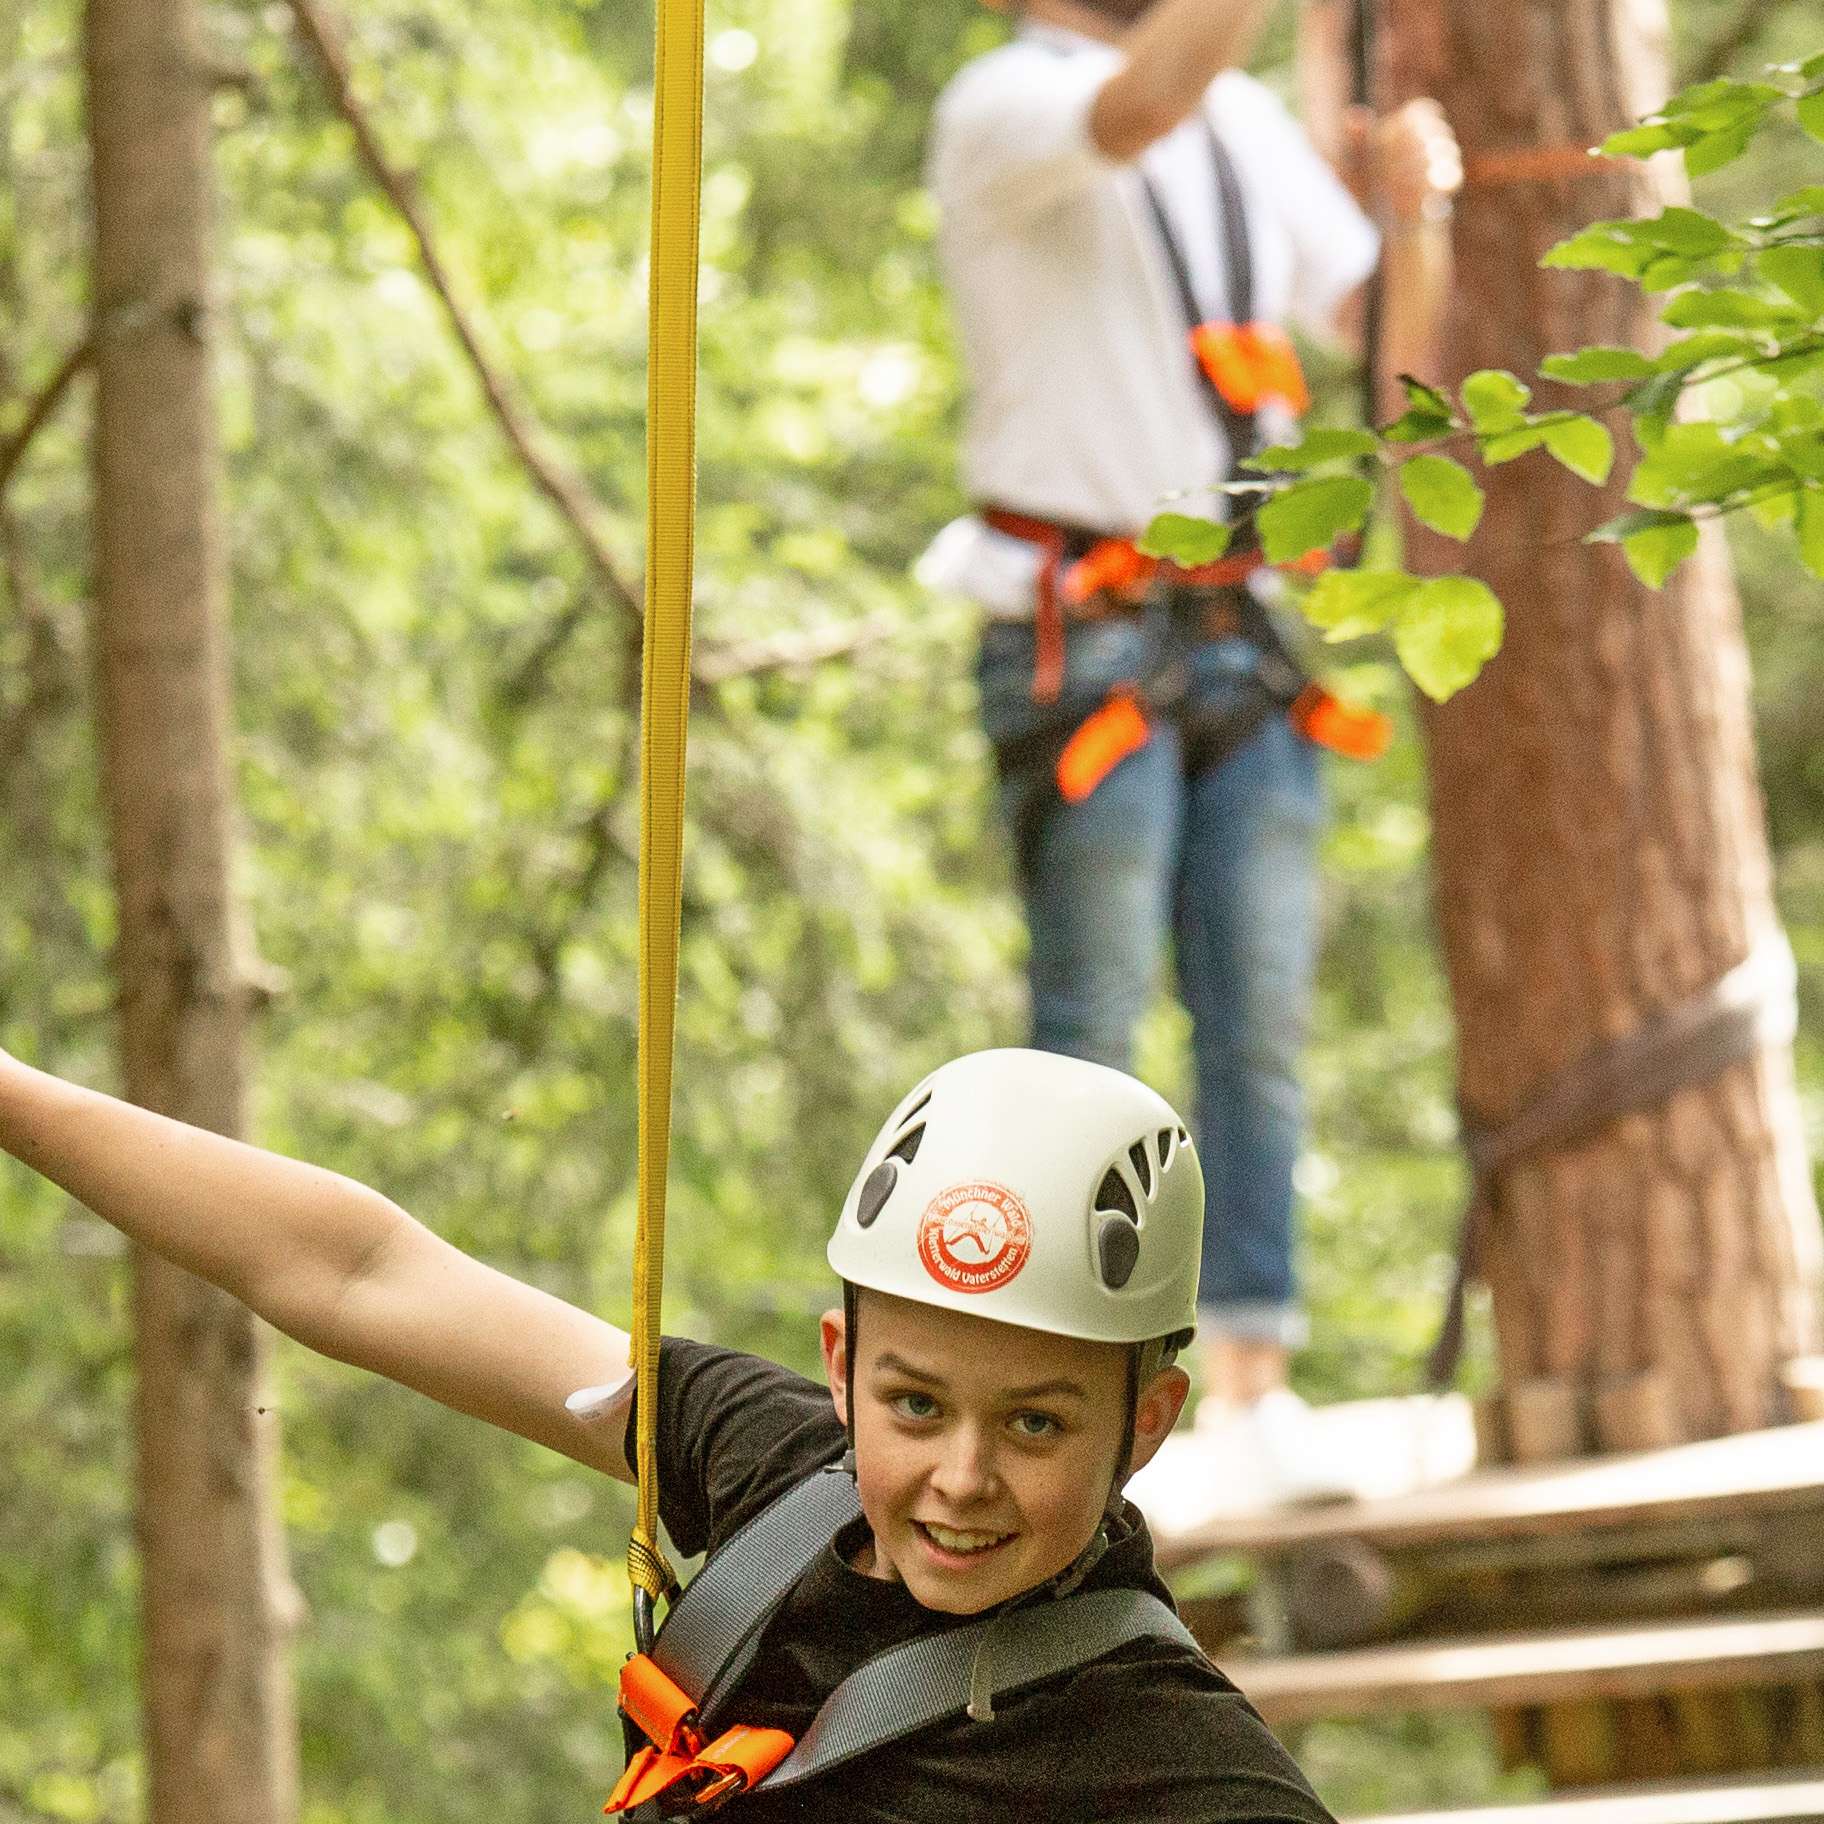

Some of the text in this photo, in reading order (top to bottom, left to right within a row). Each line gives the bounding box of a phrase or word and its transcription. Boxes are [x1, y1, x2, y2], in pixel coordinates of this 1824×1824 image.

[941, 1187, 1024, 1227] Münchner Wald
[962, 1246, 1018, 1284] Vaterstetten
